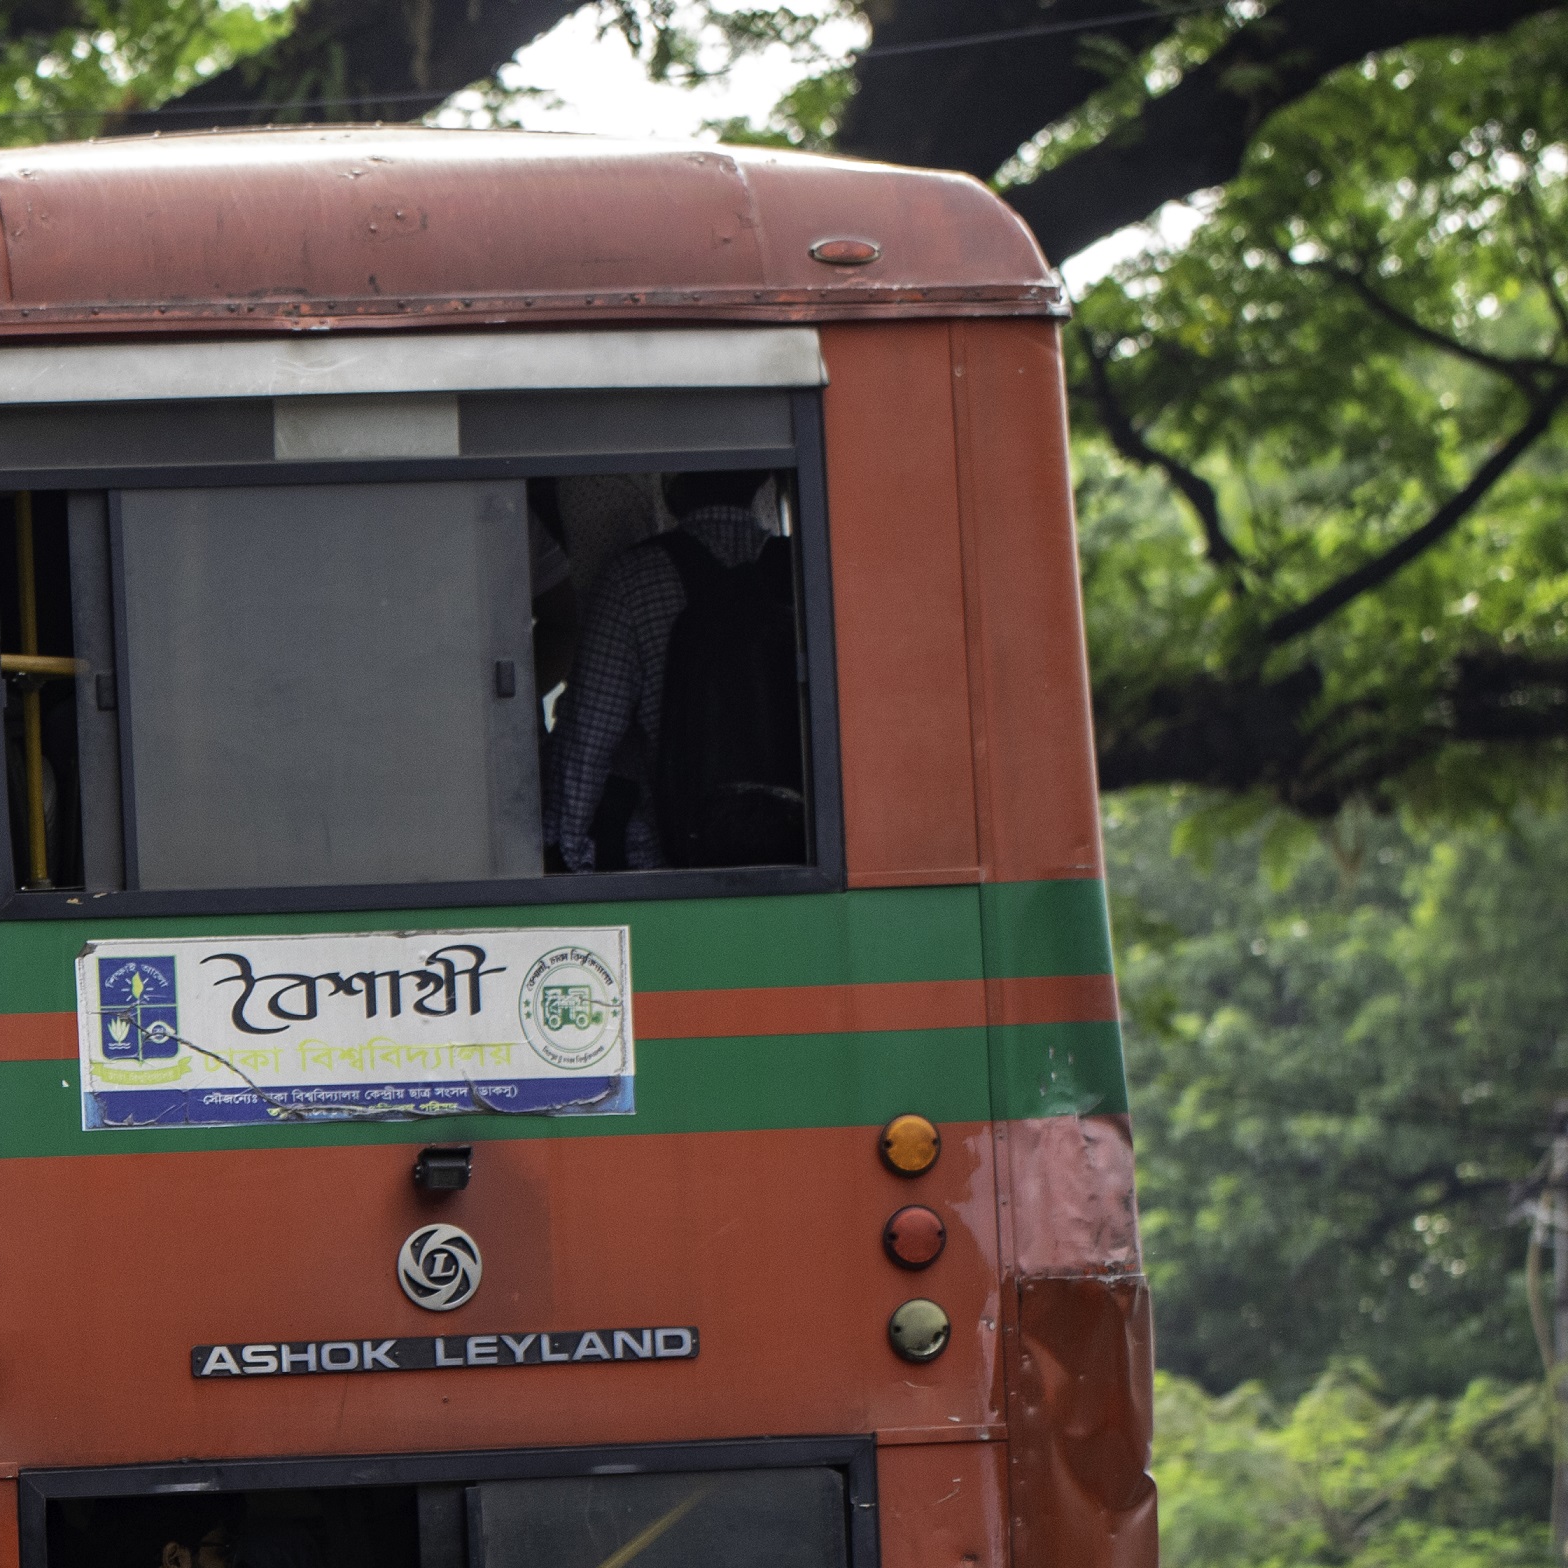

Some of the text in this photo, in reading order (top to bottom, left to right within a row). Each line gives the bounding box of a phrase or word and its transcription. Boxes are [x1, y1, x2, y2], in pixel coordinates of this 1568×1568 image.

[199, 944, 506, 1035] বৈশাখী
[203, 1036, 514, 1074] ঢাকা বিশ্ববিদ্যালয়
[292, 1089, 361, 1103] বিশ্ববিদ্যালয়
[364, 1085, 405, 1101] কেন্দ্রীয়
[434, 1086, 469, 1098] সংসদ
[200, 1328, 693, 1376] ASHOK LEYLAND
